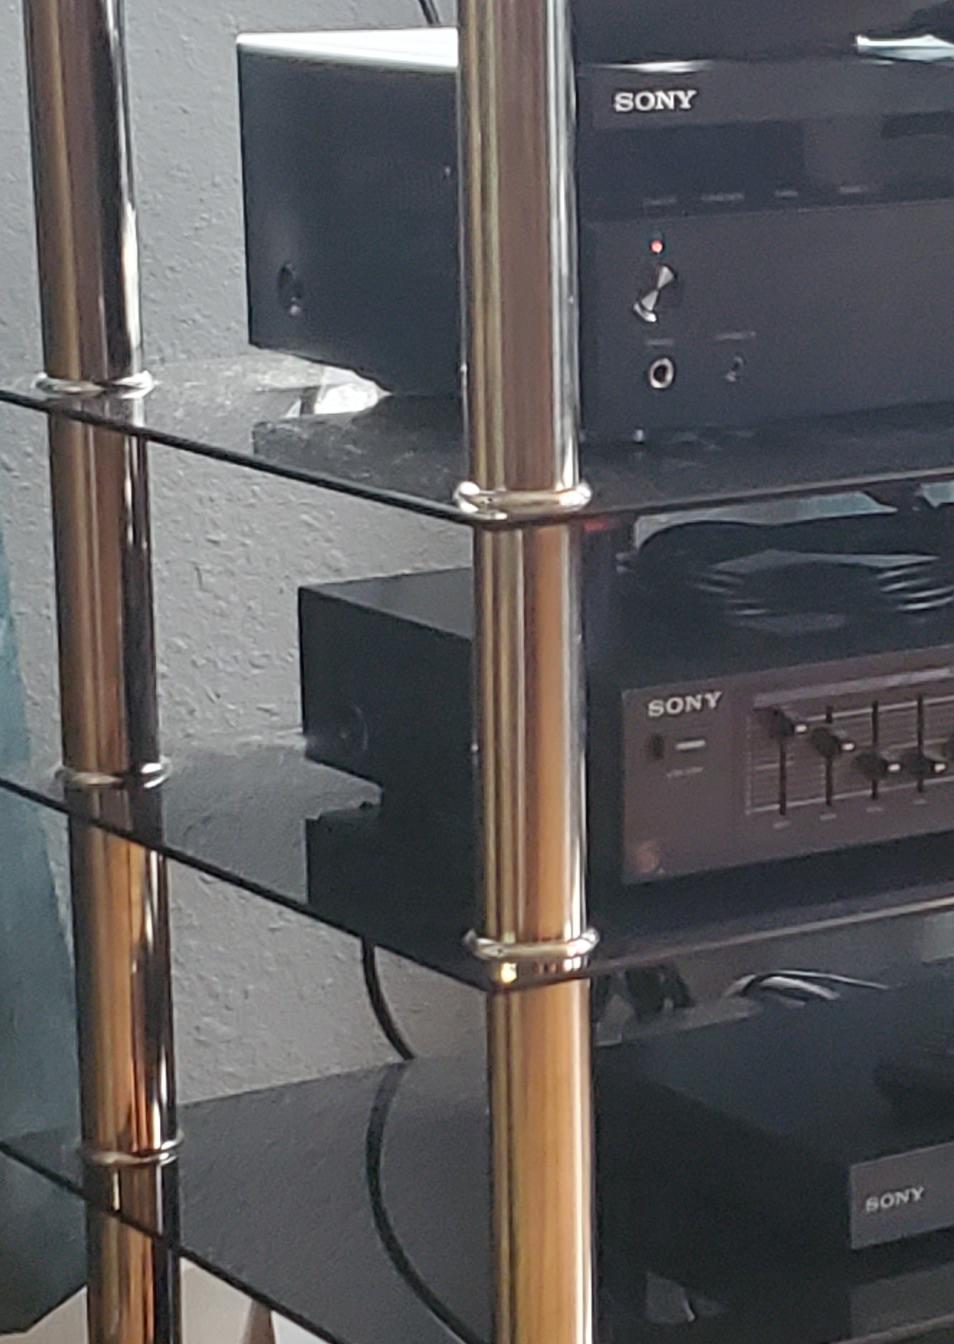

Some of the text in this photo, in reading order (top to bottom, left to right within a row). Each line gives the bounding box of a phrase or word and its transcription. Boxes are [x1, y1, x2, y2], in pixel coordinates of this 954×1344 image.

[613, 89, 697, 113] SONY
[648, 691, 722, 717] SONY
[865, 1185, 925, 1214] SONY
